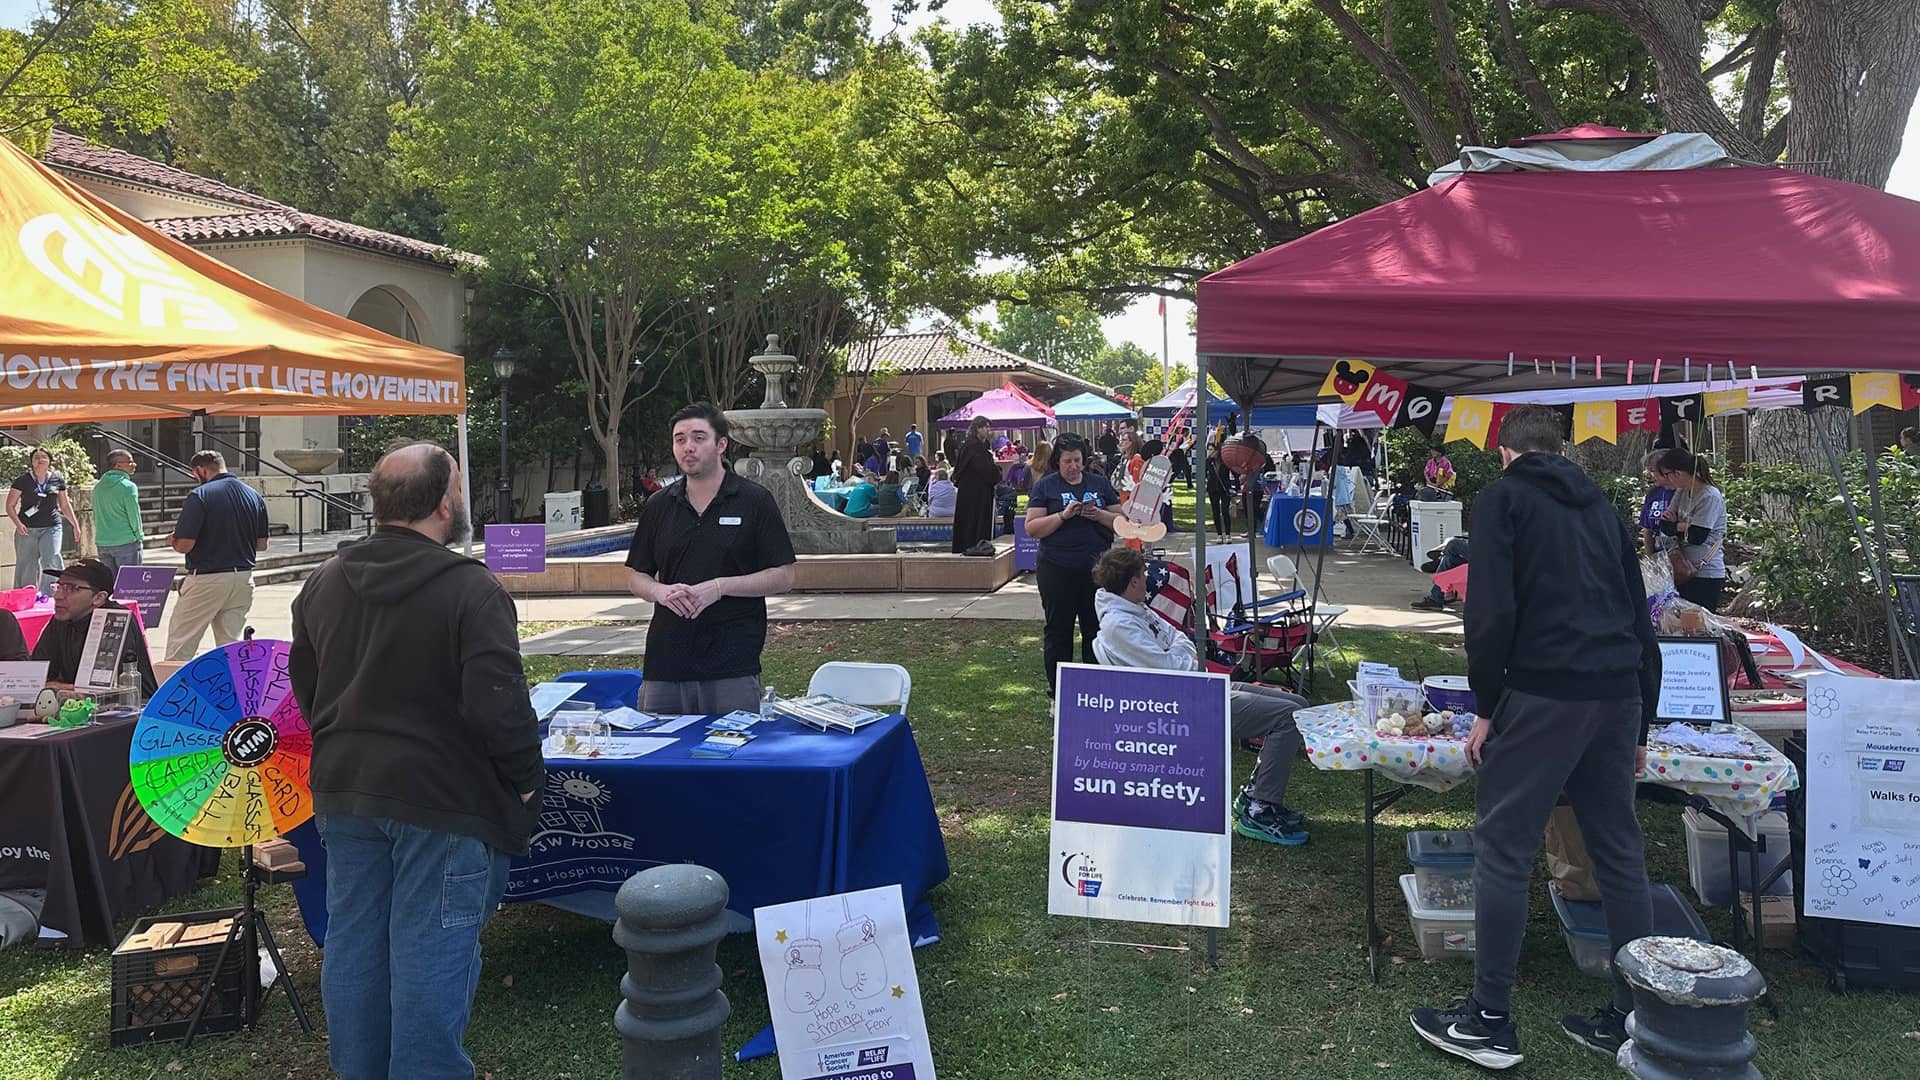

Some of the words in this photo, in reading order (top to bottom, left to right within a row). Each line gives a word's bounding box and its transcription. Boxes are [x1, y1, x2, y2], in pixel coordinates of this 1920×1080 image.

[0, 353, 81, 389] OIN
[90, 359, 163, 391] THE
[166, 362, 264, 392] FINFIT
[271, 365, 327, 396] LIFE
[331, 371, 459, 404] MOVEMENT!
[191, 657, 239, 712] CARD
[158, 684, 221, 732] BALL
[1076, 693, 1114, 712] Help
[1119, 698, 1179, 714] protect
[1114, 723, 1143, 734] your
[1147, 719, 1190, 737] skin
[139, 726, 221, 750] GLASSES
[1085, 739, 1111, 750] from
[1115, 739, 1177, 756] cancer
[1866, 743, 1919, 752] Mouseketeers
[145, 752, 209, 789] CARD
[1074, 756, 1090, 770] by
[1092, 757, 1127, 773] being
[1130, 762, 1165, 774] smart
[1168, 764, 1205, 777] about
[196, 773, 241, 826] BALL
[264, 767, 299, 817] CARD
[1074, 776, 1116, 795] sun
[1124, 778, 1205, 805] safety.
[1870, 789, 1905, 801] Walks
[0, 847, 22, 858] oy
[26, 846, 50, 860] the
[535, 836, 563, 853] JW
[572, 837, 634, 850] HOUSE
[546, 864, 629, 882] Hospitality
[814, 1002, 840, 1022] Hope
[846, 1000, 856, 1010] is
[806, 1011, 865, 1041] Stronger
[867, 1006, 886, 1016] than
[865, 1016, 894, 1034] Fear
[824, 1050, 854, 1060] American
[865, 1048, 886, 1057] RELAY
[871, 1055, 885, 1063] LIFE
[824, 1058, 848, 1066] Cancer
[826, 1064, 850, 1072] Society
[880, 1070, 894, 1080] to
